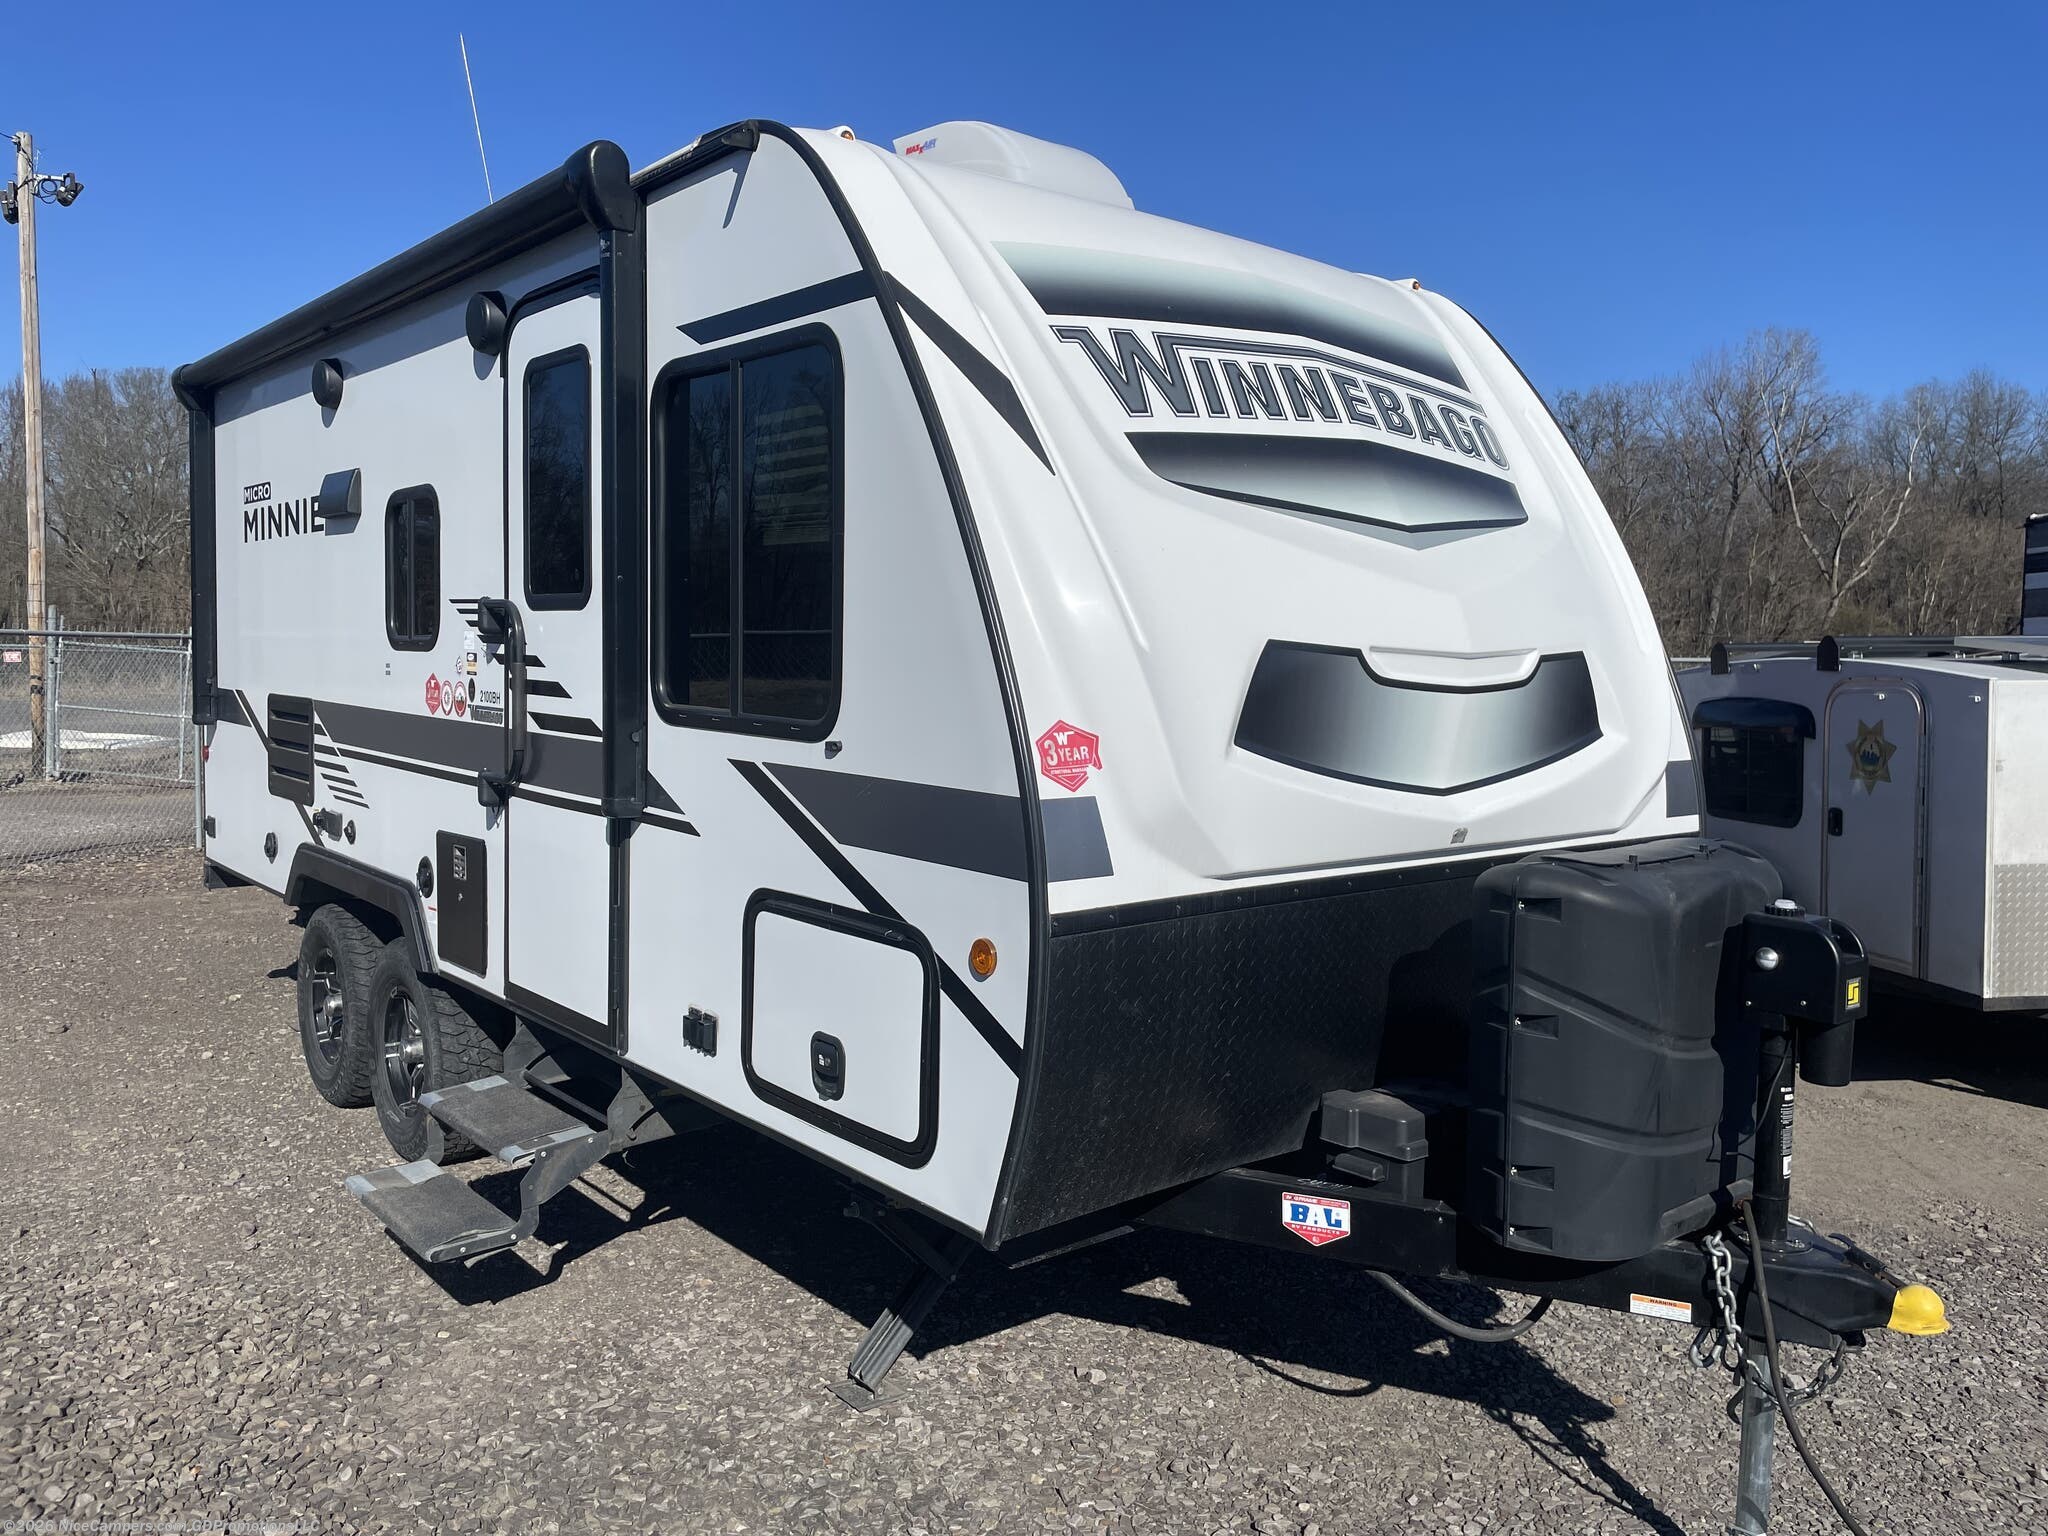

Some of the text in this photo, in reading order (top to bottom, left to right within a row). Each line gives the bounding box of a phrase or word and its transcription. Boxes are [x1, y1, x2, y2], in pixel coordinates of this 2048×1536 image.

[1049, 324, 1510, 470] WINNEBAGO
[244, 485, 270, 503] MICRO
[244, 496, 325, 543] MINNIE
[480, 689, 501, 704] 2100BH
[1044, 740, 1090, 767] 3 YEAR
[1290, 1203, 1342, 1228] BAL
[1649, 1298, 1678, 1308] WARNING
